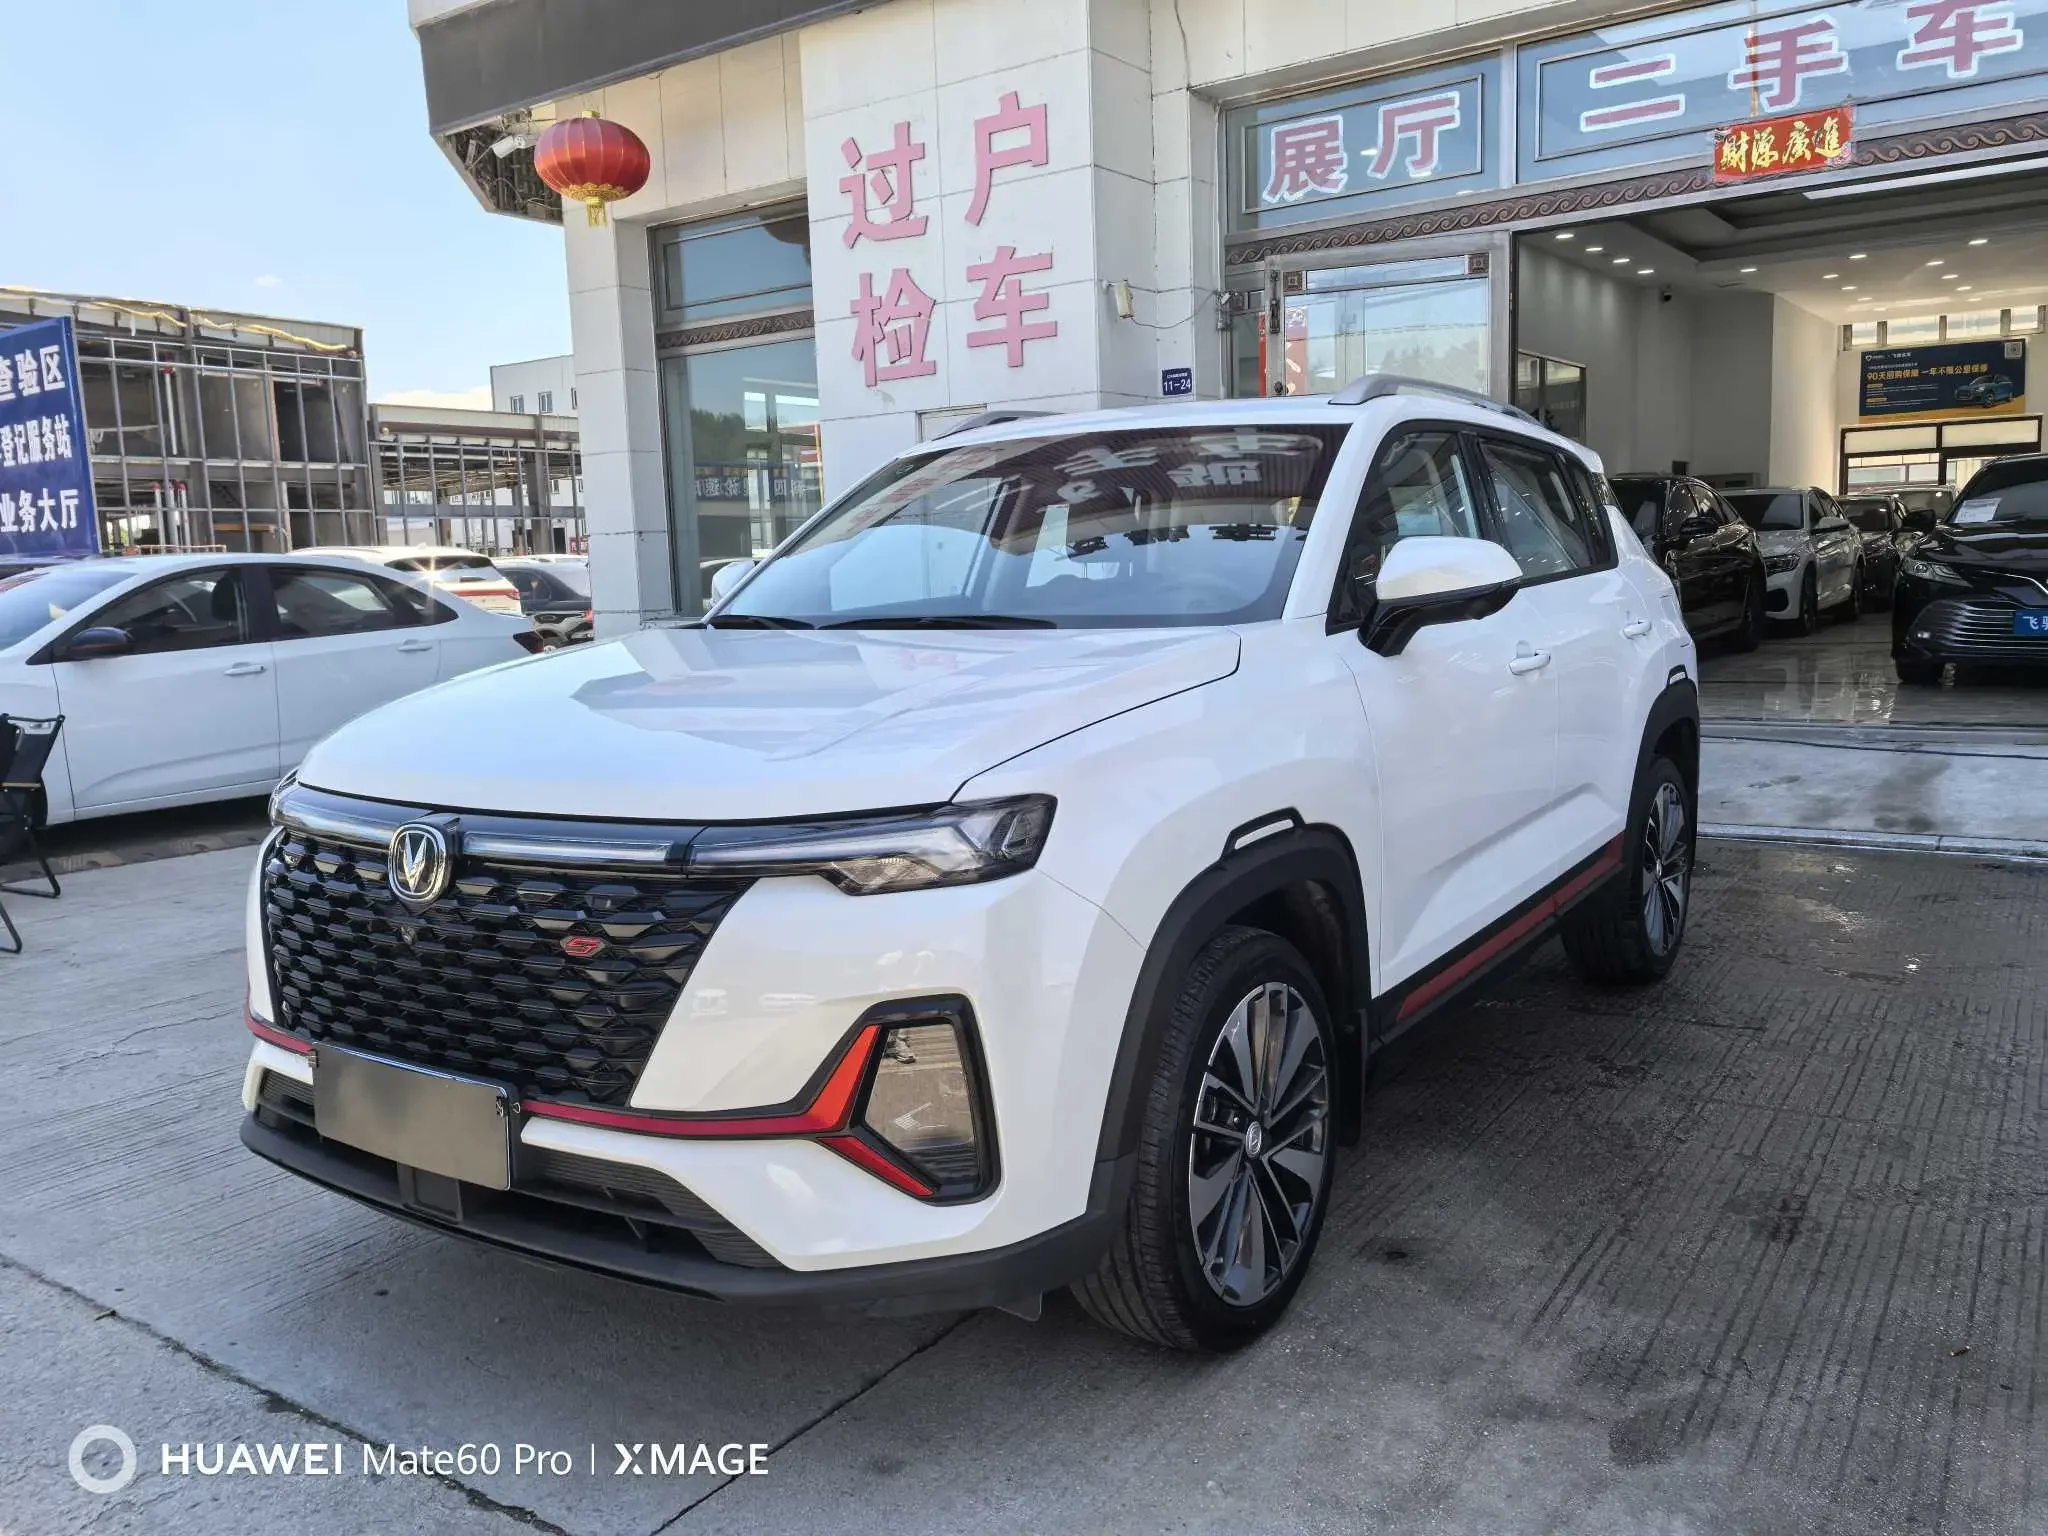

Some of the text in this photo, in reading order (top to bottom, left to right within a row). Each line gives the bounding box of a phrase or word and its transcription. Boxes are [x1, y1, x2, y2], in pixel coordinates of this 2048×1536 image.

[1581, 0, 2024, 131] 二手车
[839, 91, 1050, 249] 过户
[1263, 91, 1461, 203] 展厅
[851, 246, 1058, 387] 检车
[0, 413, 72, 467] 登记服务站
[1163, 378, 1191, 392] 11-24
[0, 487, 79, 533] 业务大厅
